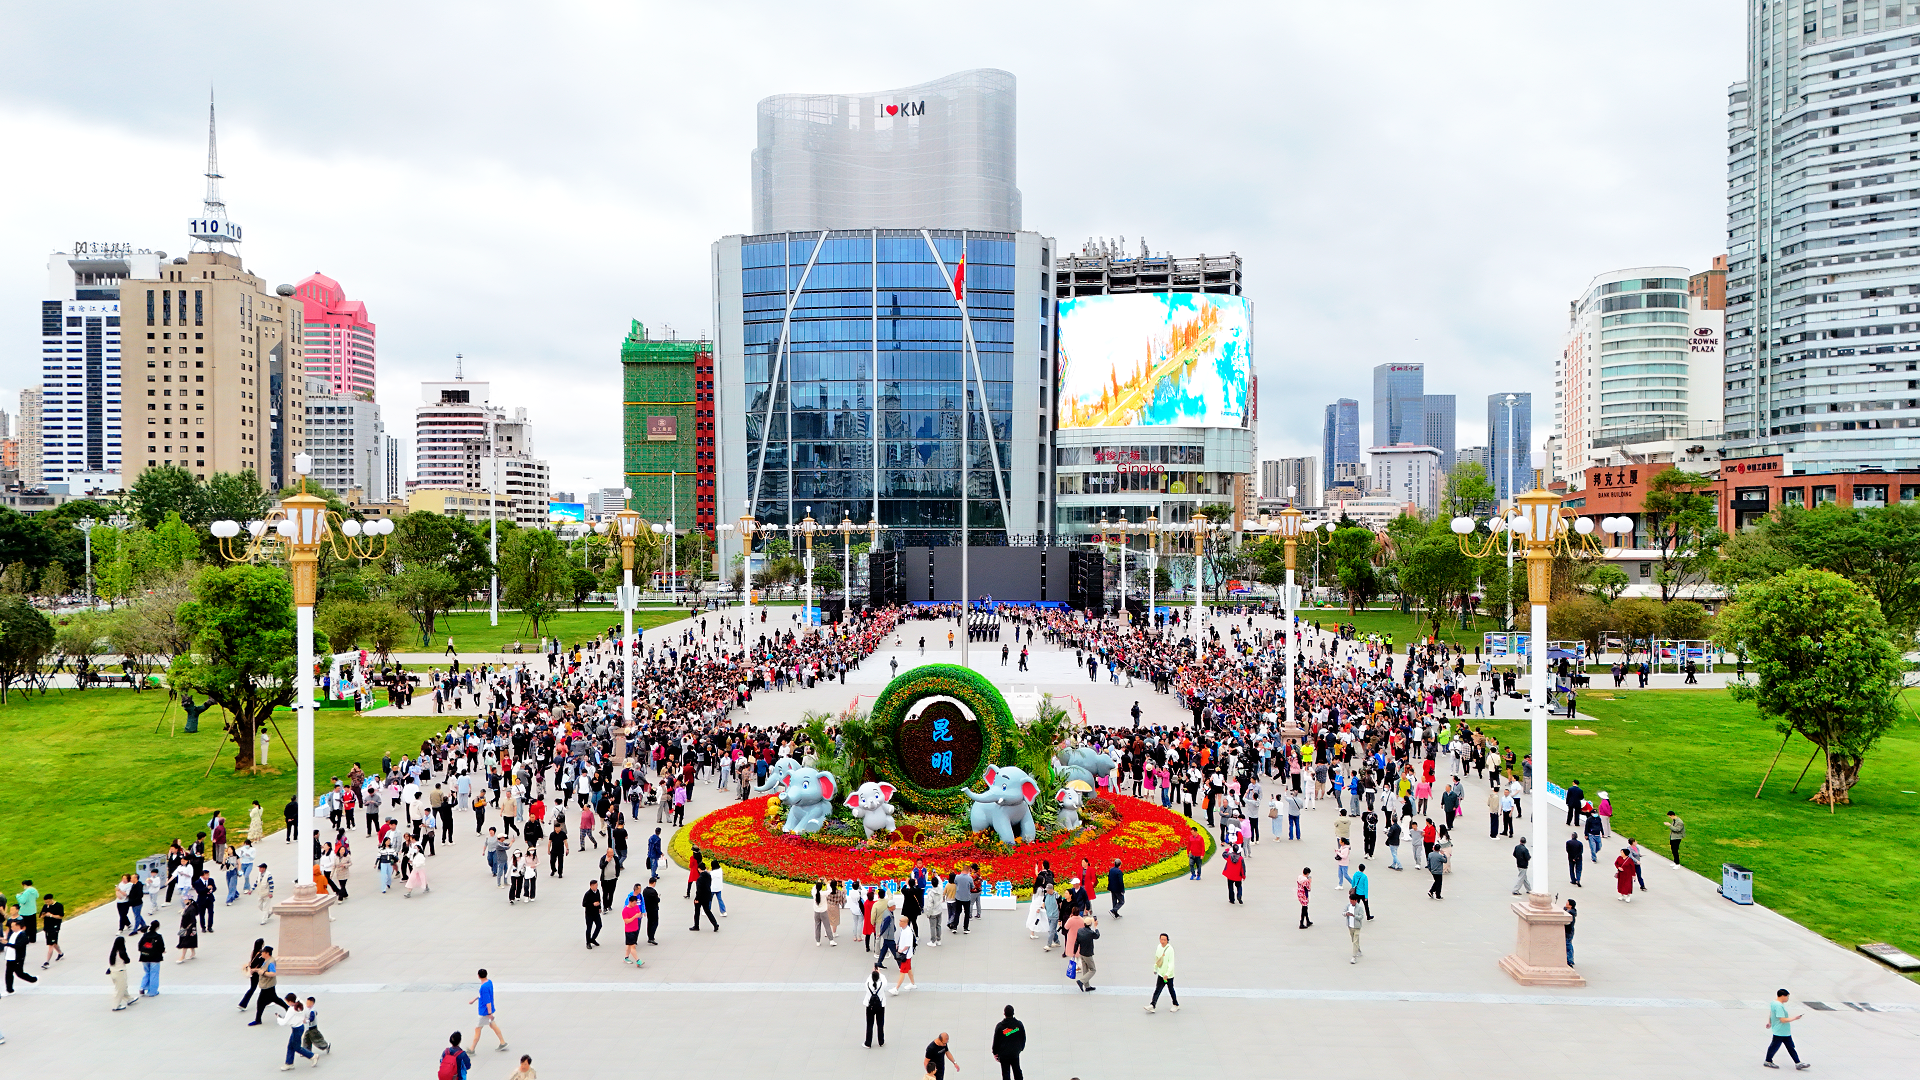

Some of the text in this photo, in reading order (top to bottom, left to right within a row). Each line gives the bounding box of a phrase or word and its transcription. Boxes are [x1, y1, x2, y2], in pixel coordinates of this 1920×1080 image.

[901, 100, 925, 117] KM
[190, 219, 219, 233] 110
[225, 222, 242, 240] 110
[1116, 461, 1165, 476] Gingko
[1593, 469, 1638, 487] 邦克大厦
[931, 718, 954, 776] 昆明
